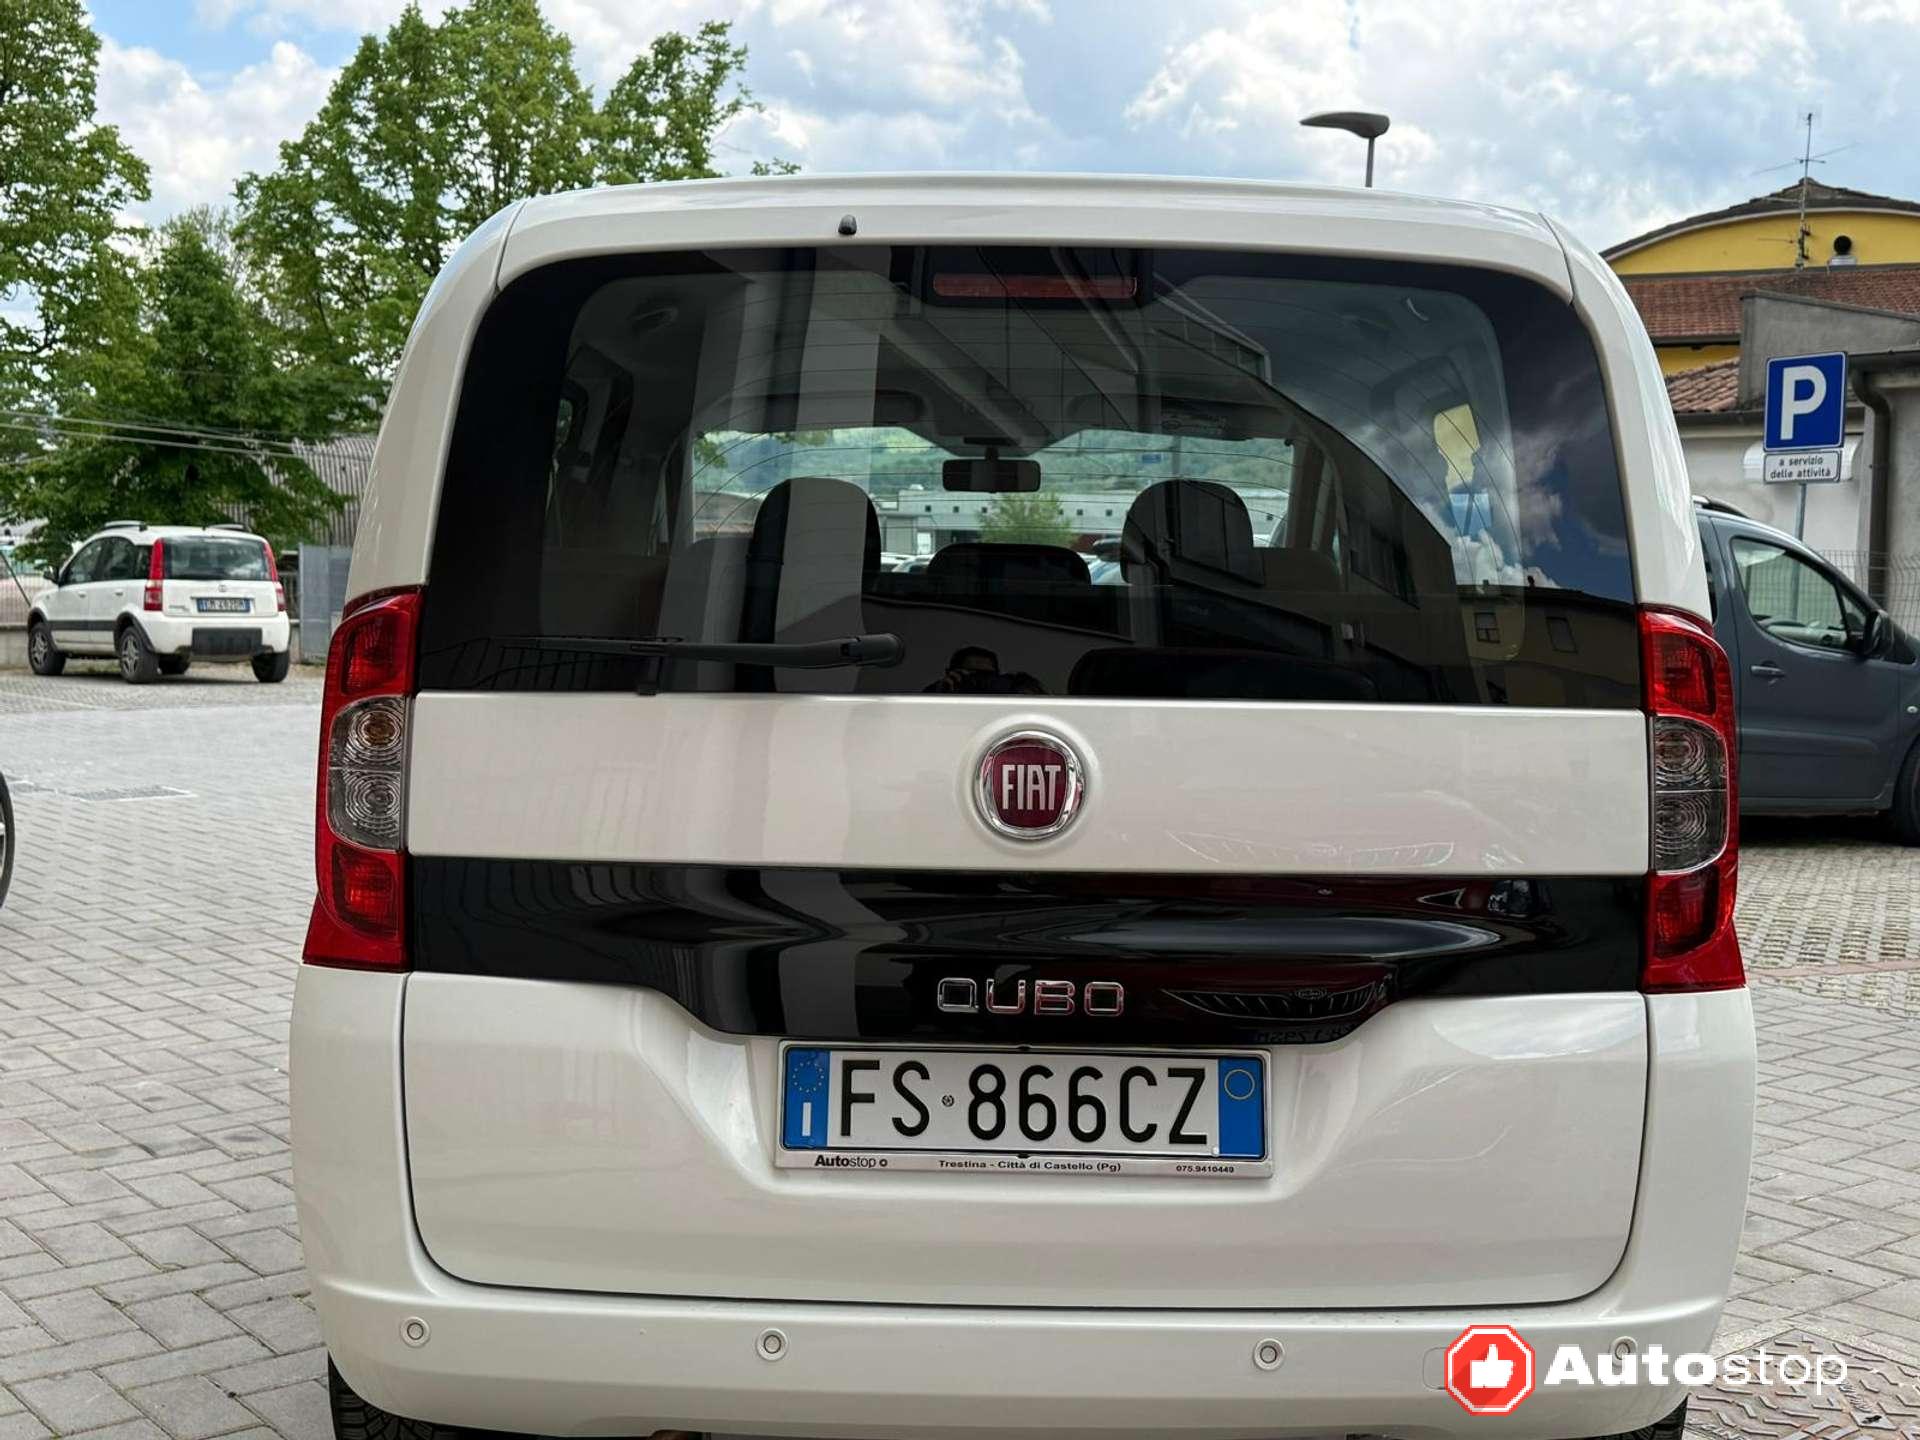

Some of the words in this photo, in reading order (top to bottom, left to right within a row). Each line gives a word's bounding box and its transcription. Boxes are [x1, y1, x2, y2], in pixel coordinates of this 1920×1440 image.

[1780, 365, 1827, 440] P
[1789, 455, 1823, 466] servizio
[1770, 470, 1793, 480] delle
[1001, 764, 1062, 811] FIAT
[937, 977, 1125, 1017] QUBO
[840, 1059, 930, 1137] FS
[968, 1063, 1208, 1145] 866CZ
[814, 1154, 876, 1169] Autostop
[938, 1160, 987, 1169] Trestina
[997, 1160, 1026, 1170] Città
[1029, 1161, 1041, 1170] di
[1044, 1161, 1093, 1171] Castello
[1096, 1162, 1121, 1173] (Pg)
